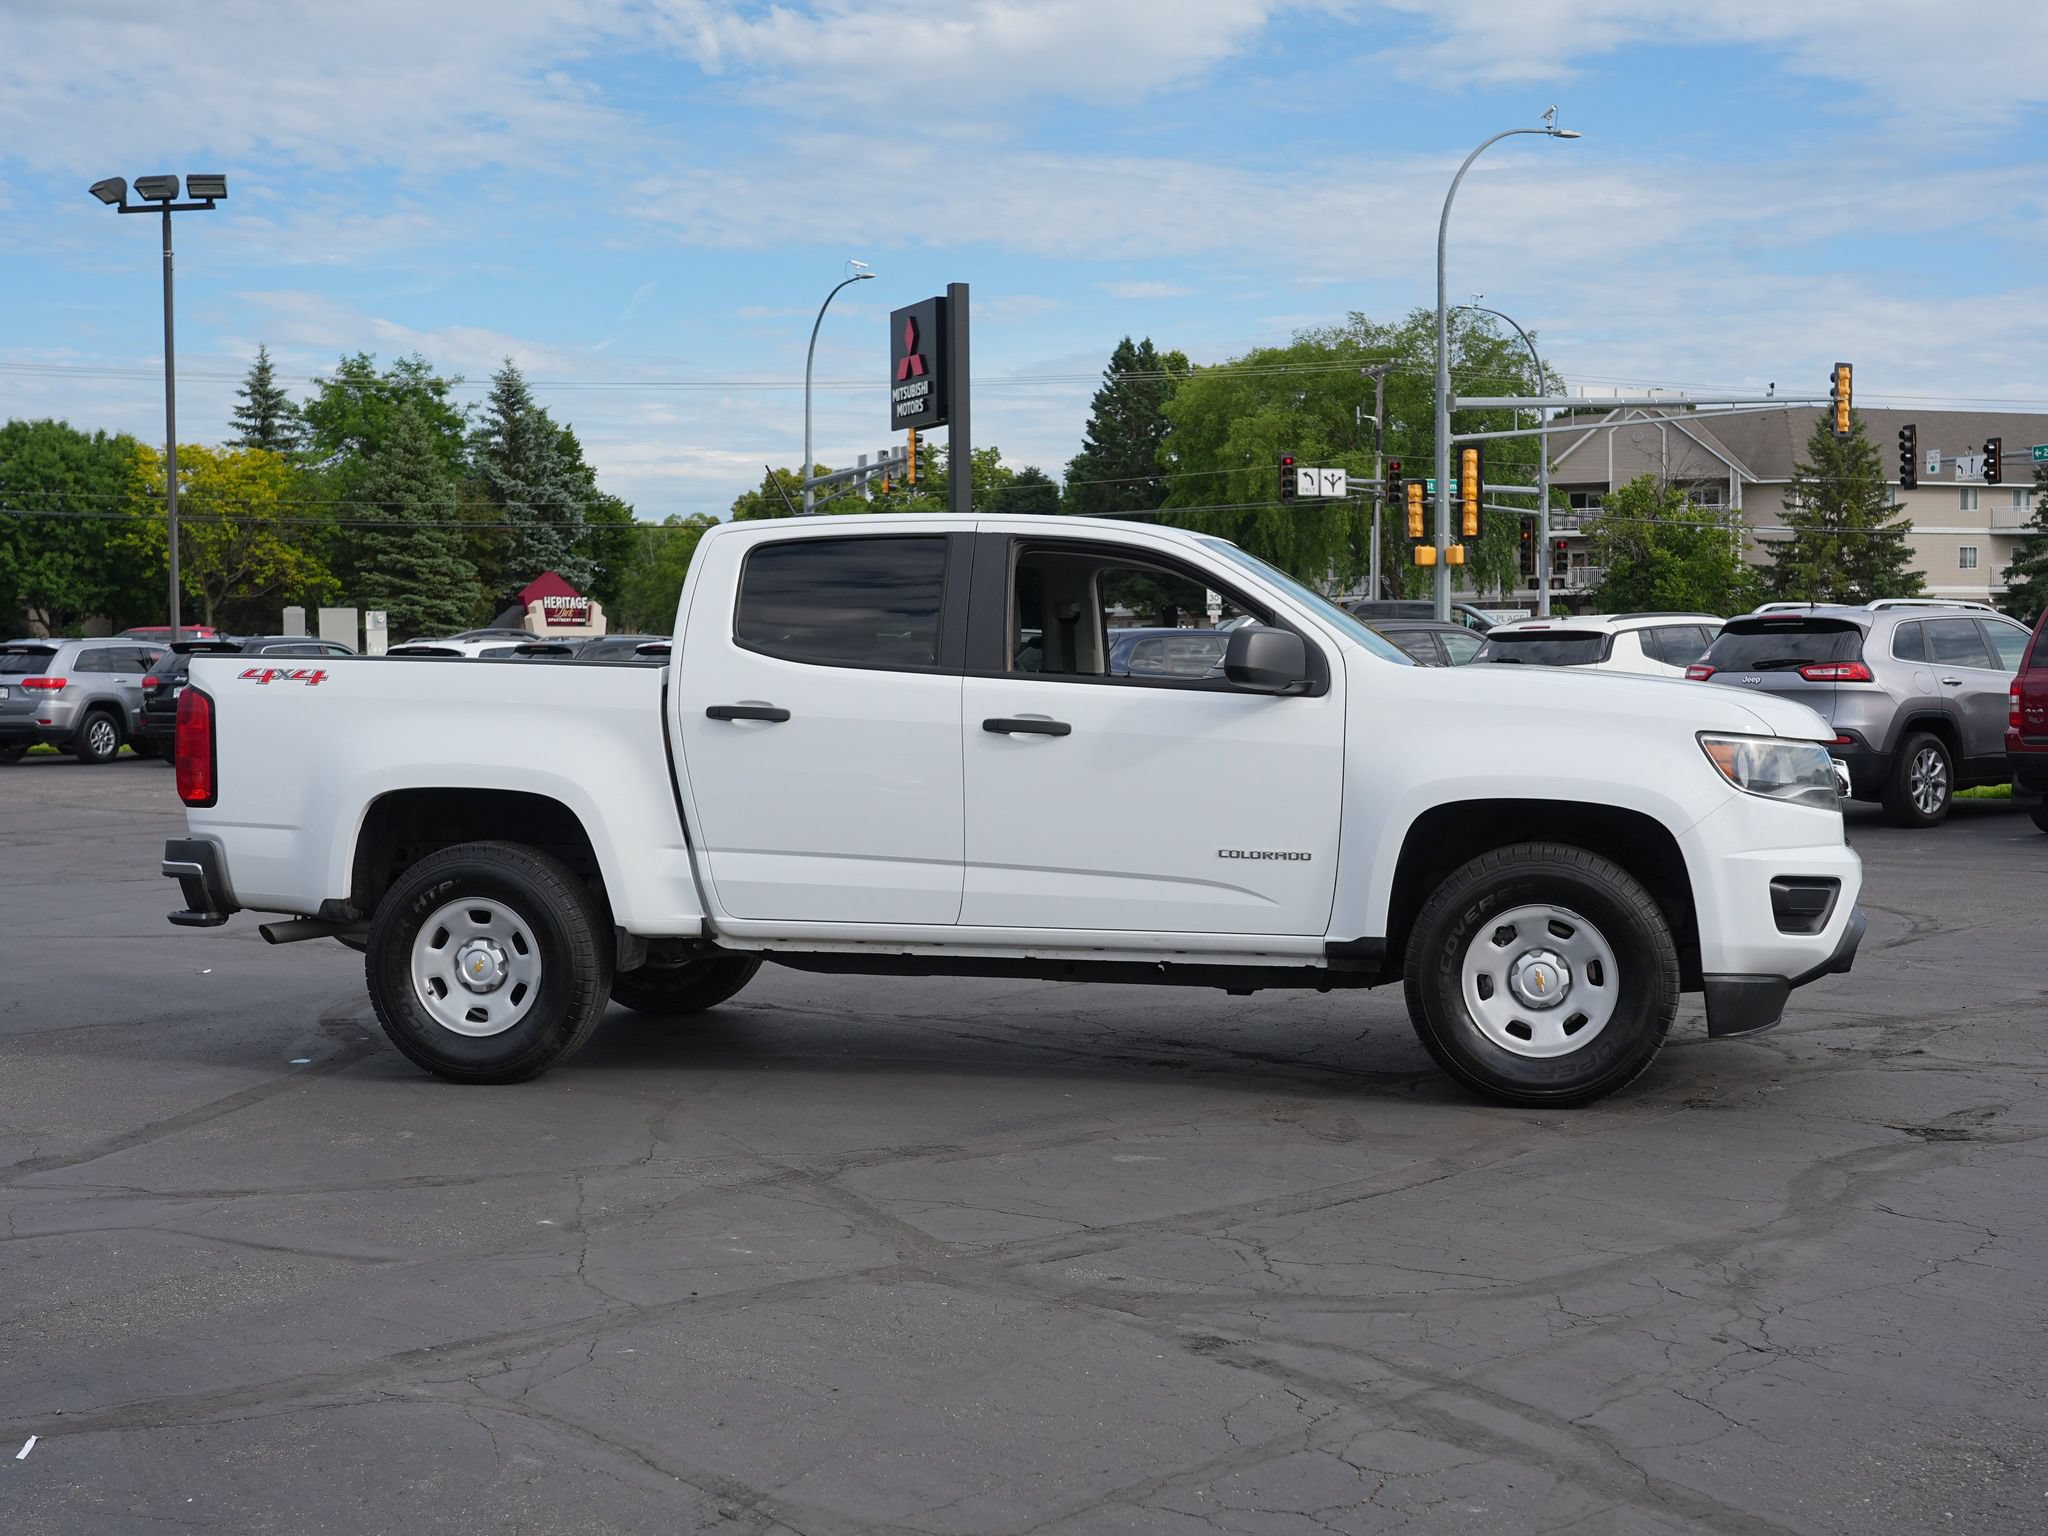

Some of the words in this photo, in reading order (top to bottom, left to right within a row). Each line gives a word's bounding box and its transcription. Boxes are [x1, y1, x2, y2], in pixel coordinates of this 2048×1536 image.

[893, 381, 928, 402] MITSUBISHI
[897, 399, 924, 417] MOTORS
[543, 596, 588, 609] HERITAGE
[1742, 675, 1762, 685] Jeep
[1218, 849, 1312, 861] COLORADO
